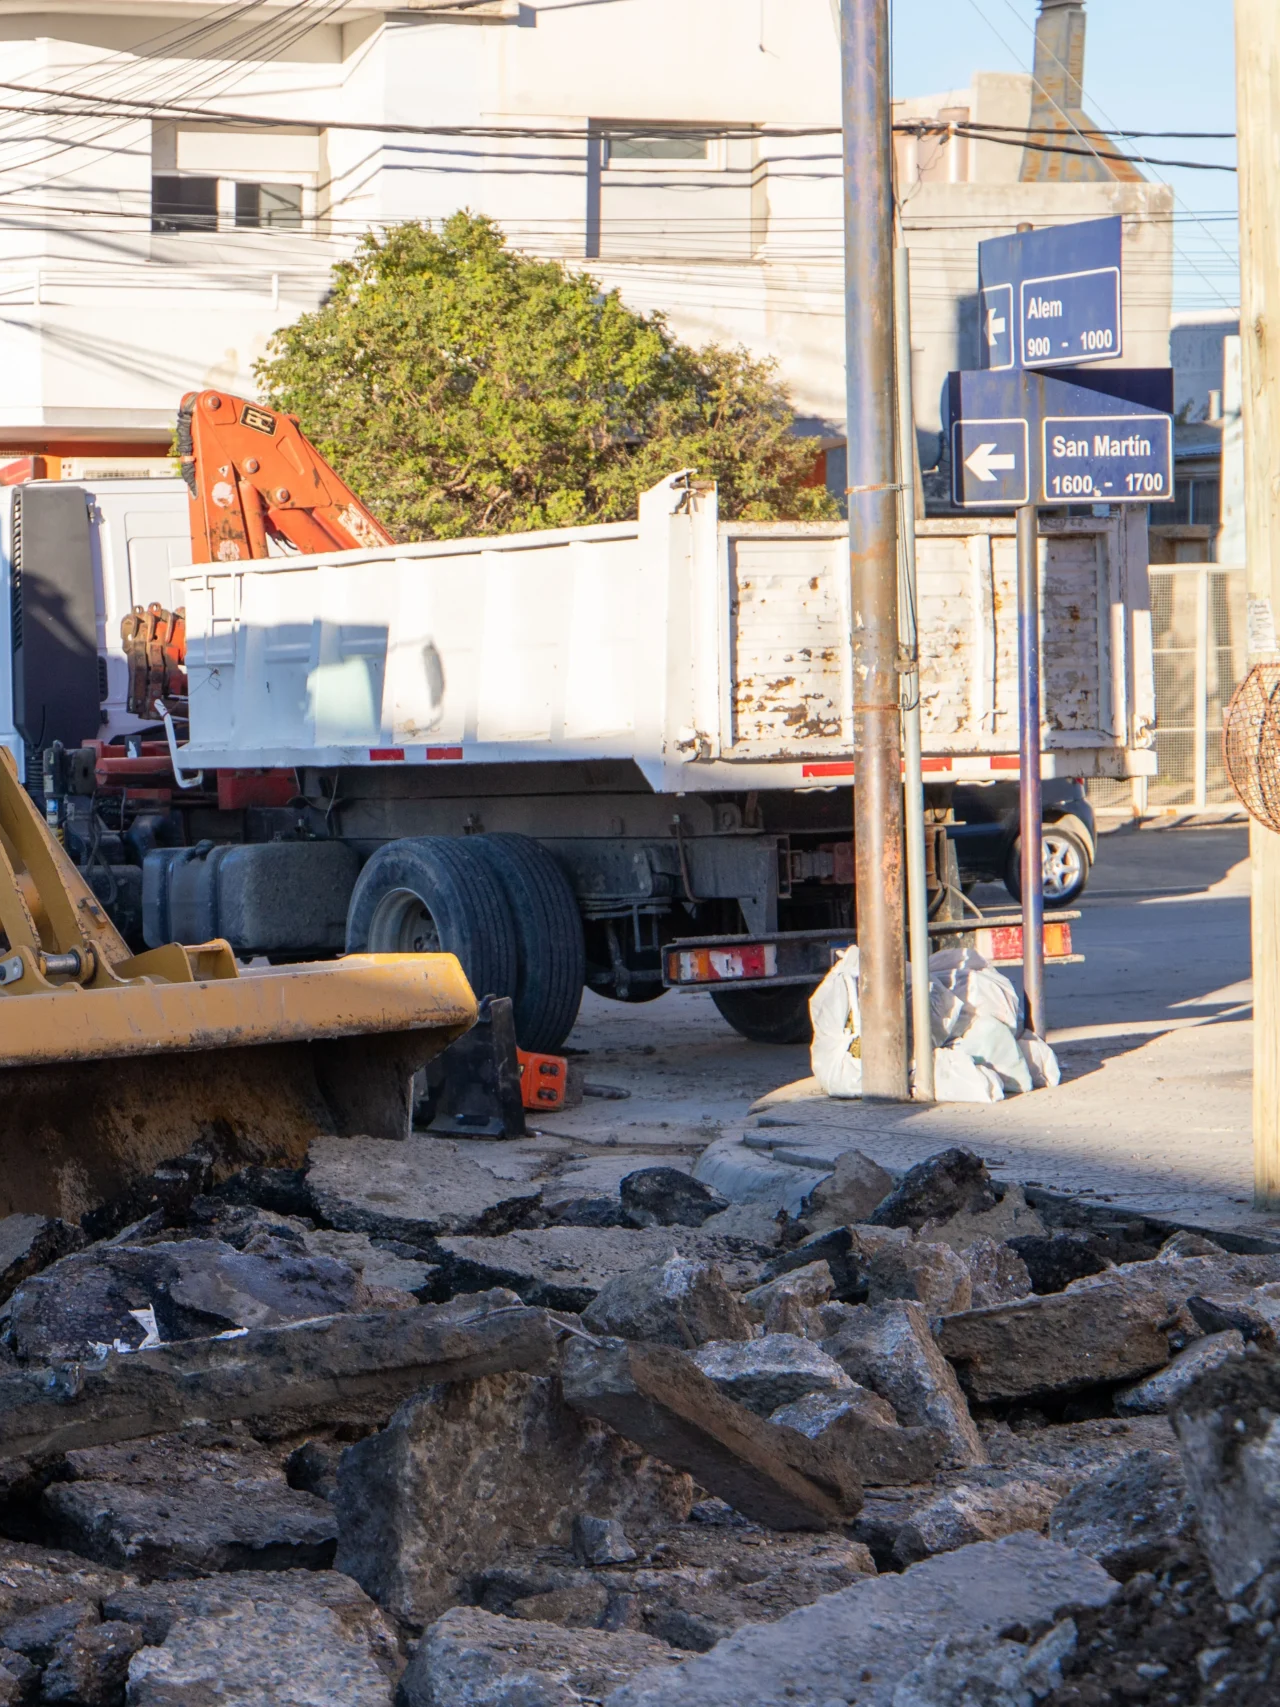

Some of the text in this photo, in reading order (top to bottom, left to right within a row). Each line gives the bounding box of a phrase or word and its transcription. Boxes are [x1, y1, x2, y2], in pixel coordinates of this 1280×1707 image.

[1027, 296, 1063, 319] Alem
[1027, 336, 1051, 357] 900
[1080, 329, 1113, 350] 1000
[1052, 434, 1151, 457] San Martín
[1052, 475, 1093, 494] 1600
[1125, 473, 1163, 491] 1700
